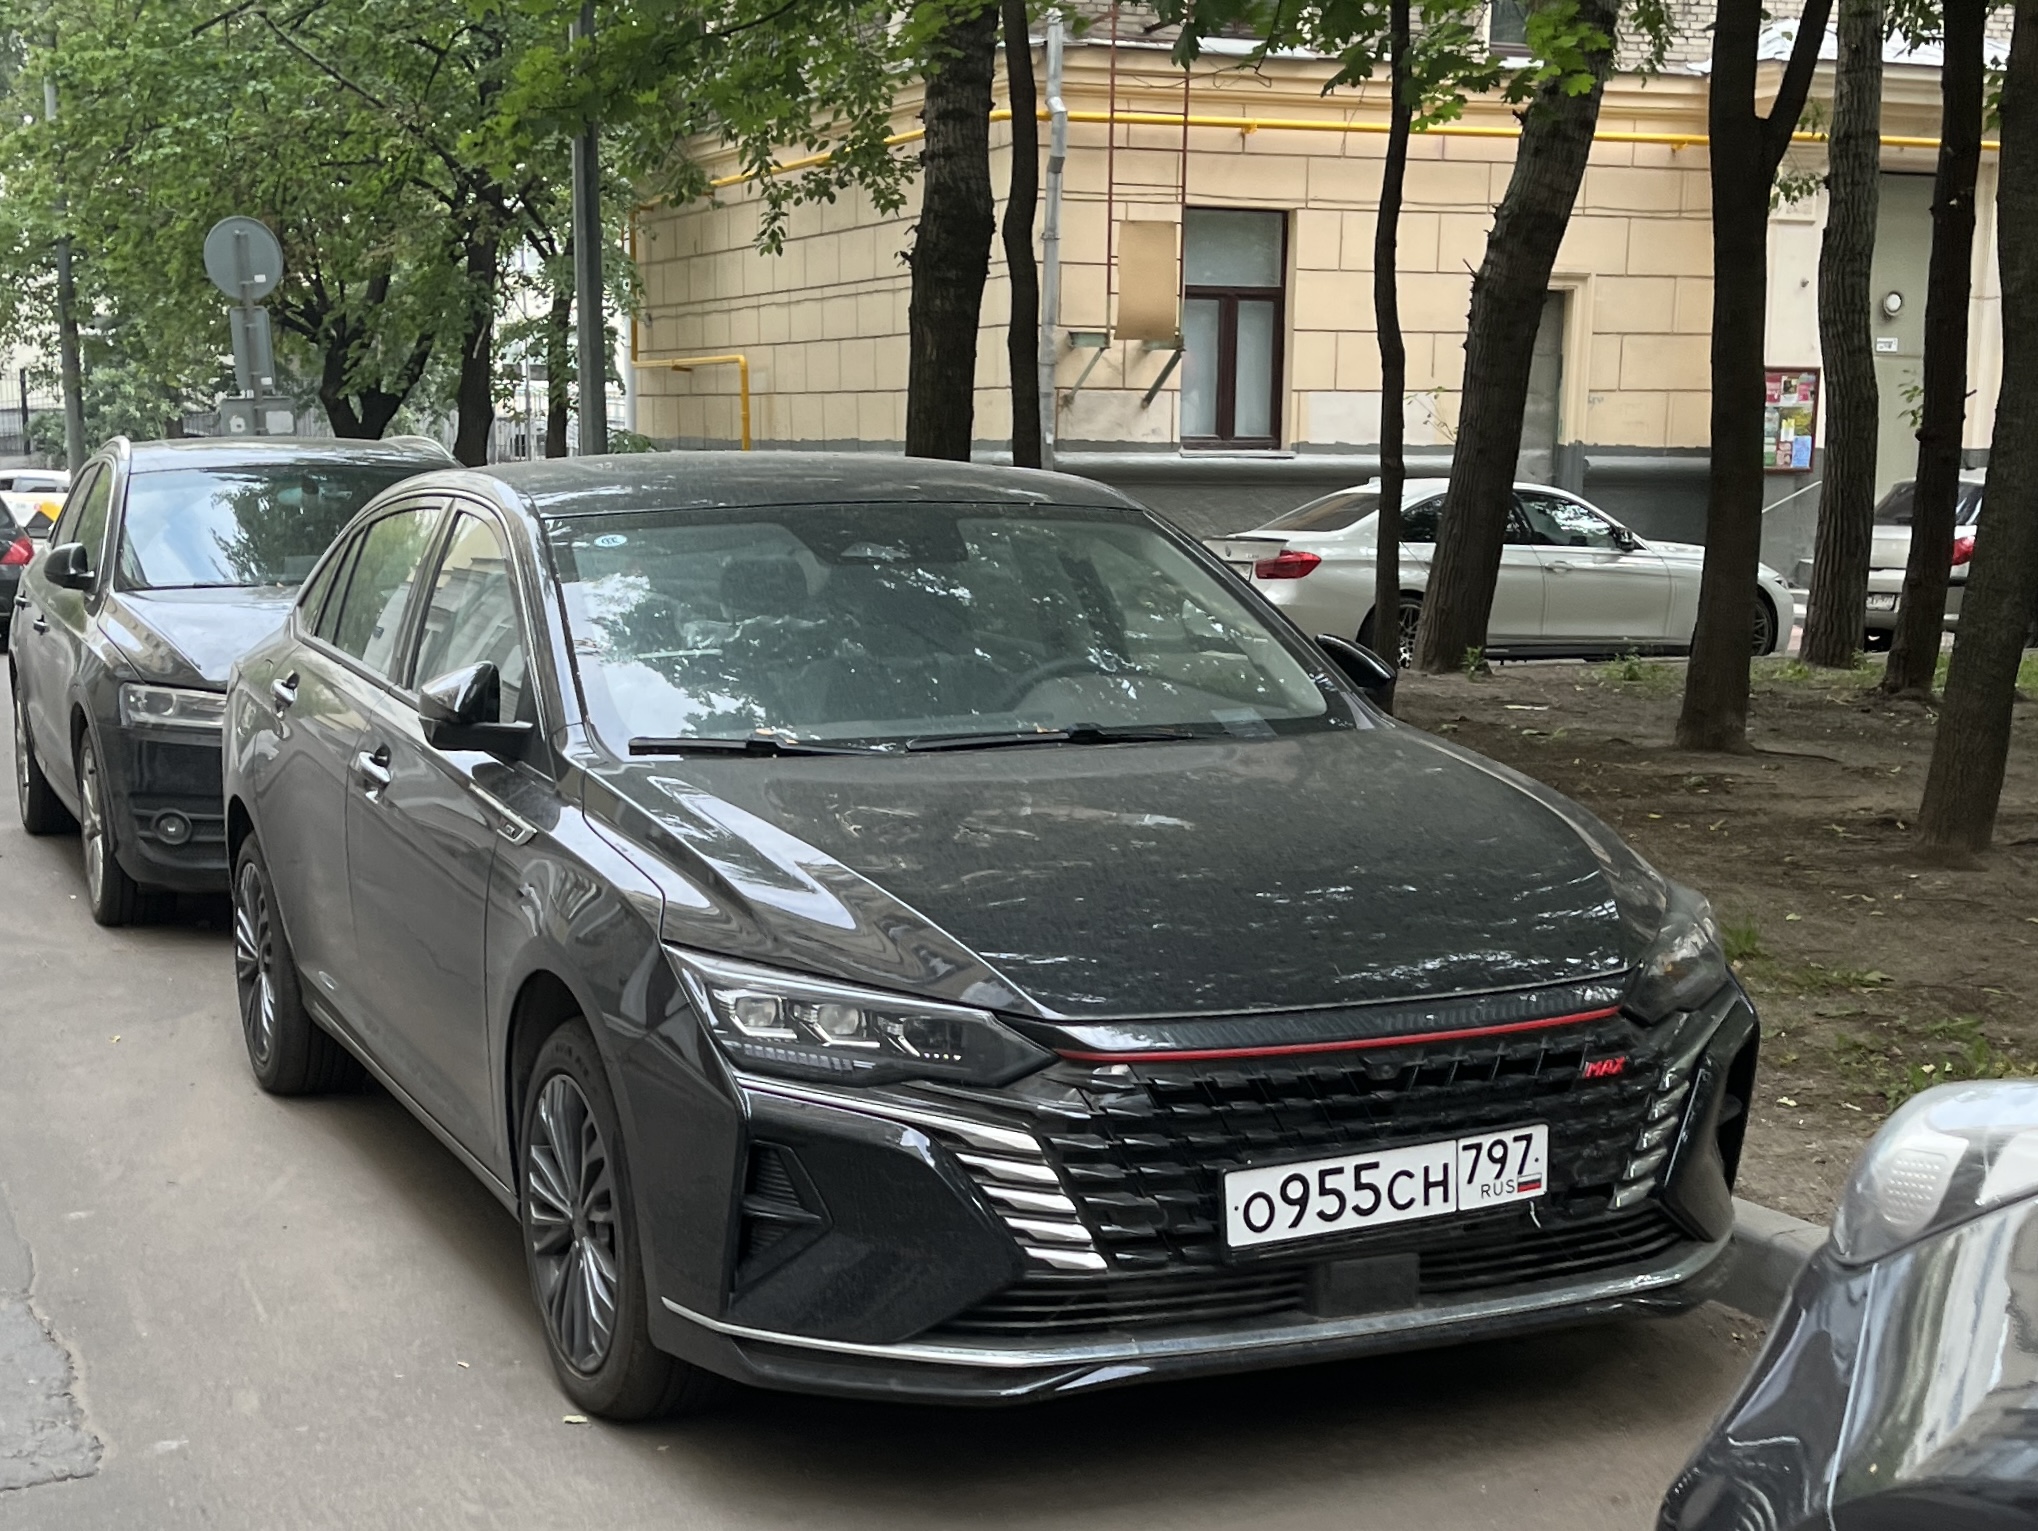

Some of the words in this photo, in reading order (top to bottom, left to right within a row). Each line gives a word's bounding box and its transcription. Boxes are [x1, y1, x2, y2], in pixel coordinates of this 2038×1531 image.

[1584, 1056, 1626, 1078] MAX
[1461, 1133, 1534, 1185] 797
[1481, 1179, 1516, 1199] RUS
